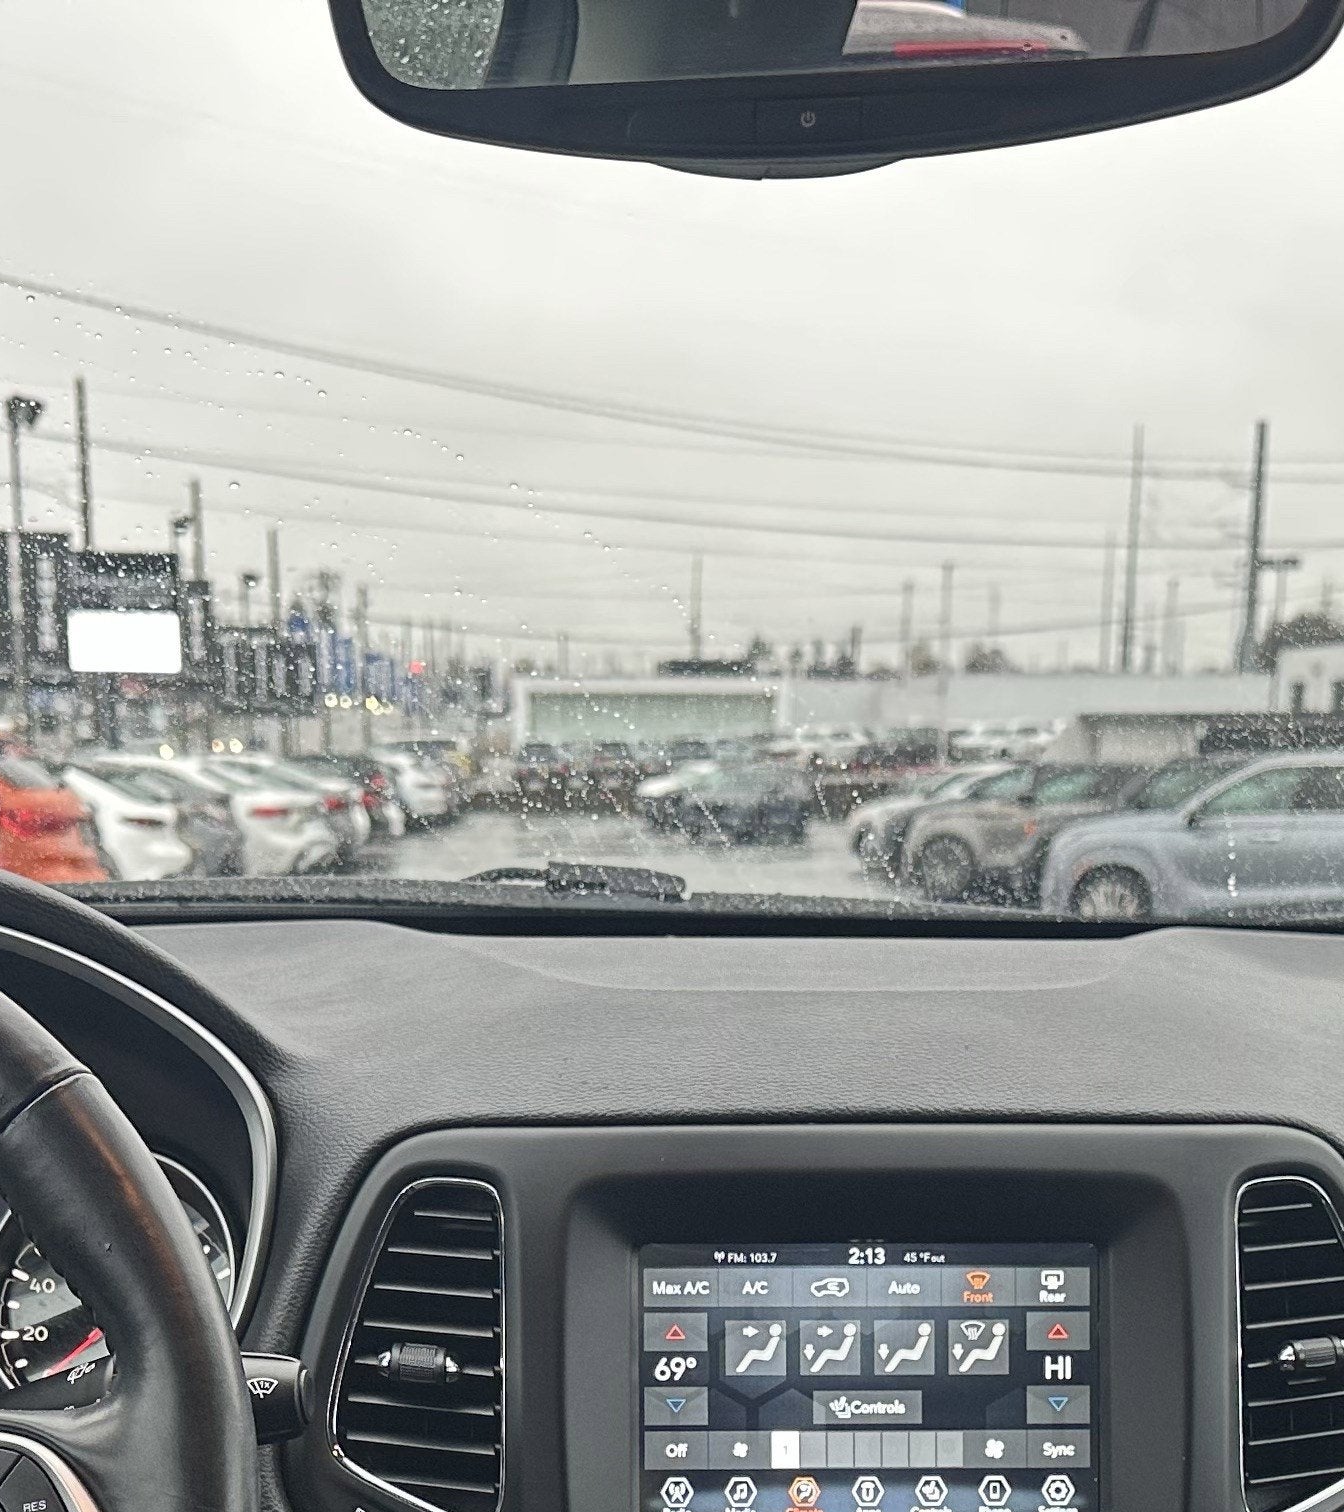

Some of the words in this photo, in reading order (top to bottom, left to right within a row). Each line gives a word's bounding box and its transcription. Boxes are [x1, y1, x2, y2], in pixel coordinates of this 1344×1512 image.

[750, 1252, 777, 1263] 103.7
[849, 1247, 885, 1264] 2:13
[904, 1252, 917, 1262] 45
[28, 1276, 56, 1294] 40
[652, 1281, 681, 1295] Max
[683, 1281, 710, 1295] A/C
[742, 1281, 769, 1294] A/C
[888, 1281, 920, 1294] Auto
[960, 1290, 996, 1304] Front
[1039, 1290, 1066, 1302] Rear
[21, 1324, 49, 1343] 20
[1045, 1356, 1071, 1379] HI
[852, 1399, 905, 1414] Controls
[666, 1443, 688, 1457] Off
[1043, 1442, 1075, 1458] Sync
[22, 1500, 47, 1512] RES
